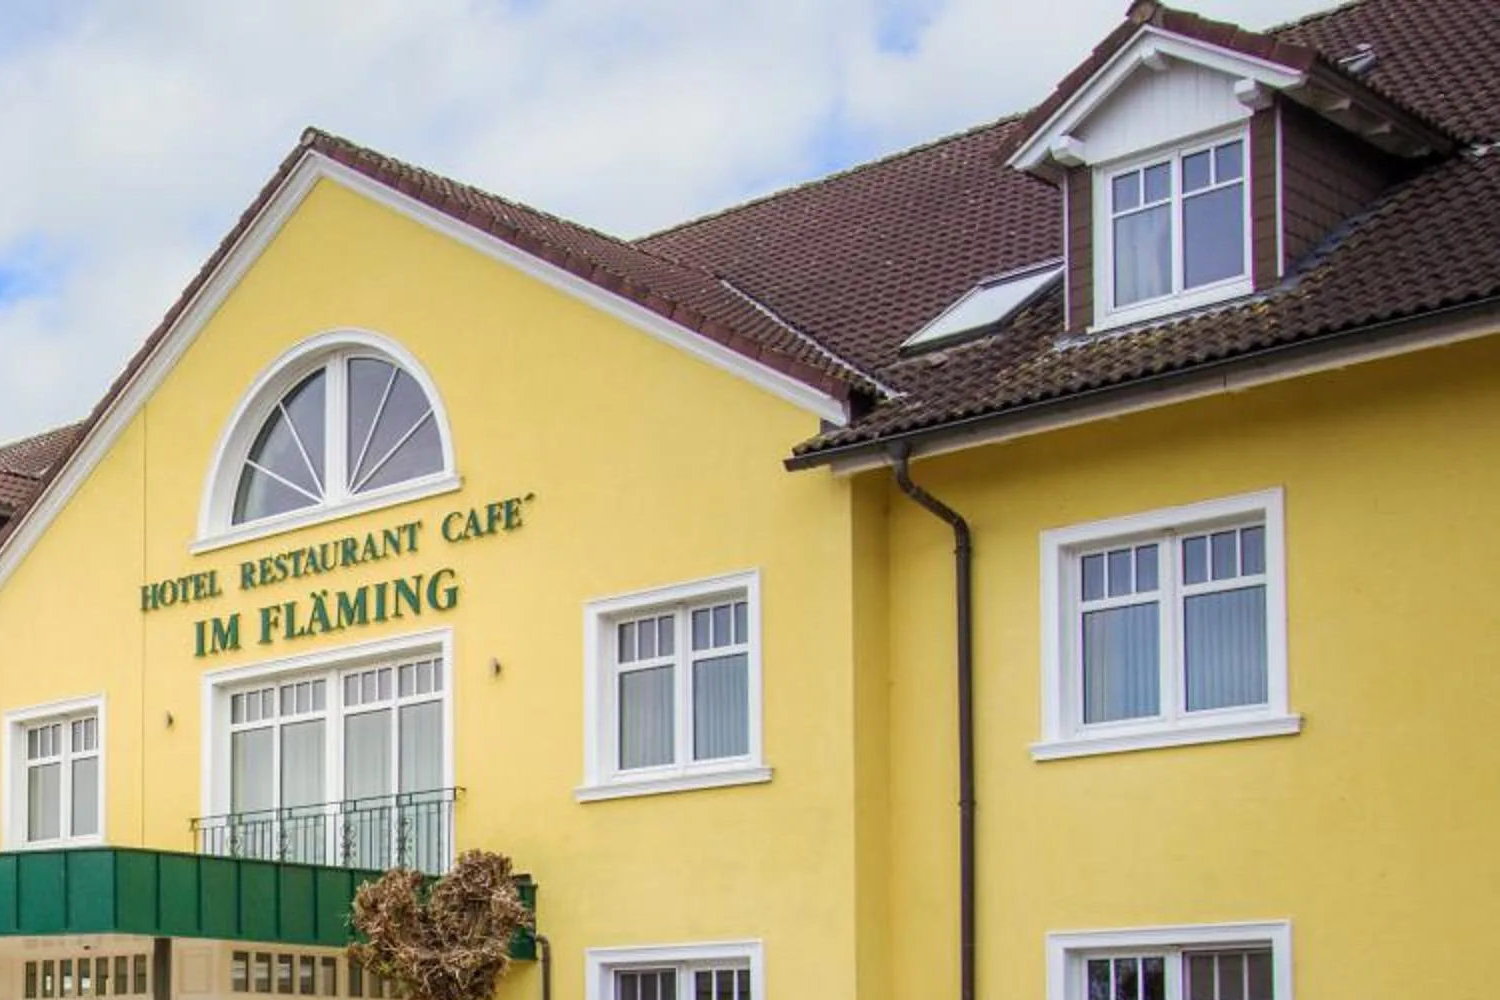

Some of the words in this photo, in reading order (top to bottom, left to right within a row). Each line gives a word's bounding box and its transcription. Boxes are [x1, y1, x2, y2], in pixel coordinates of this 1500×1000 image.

[140, 571, 222, 612] HOTEL
[240, 520, 423, 590] RESTAURANT
[194, 613, 241, 657] IM
[258, 569, 459, 645] FLÄMING
